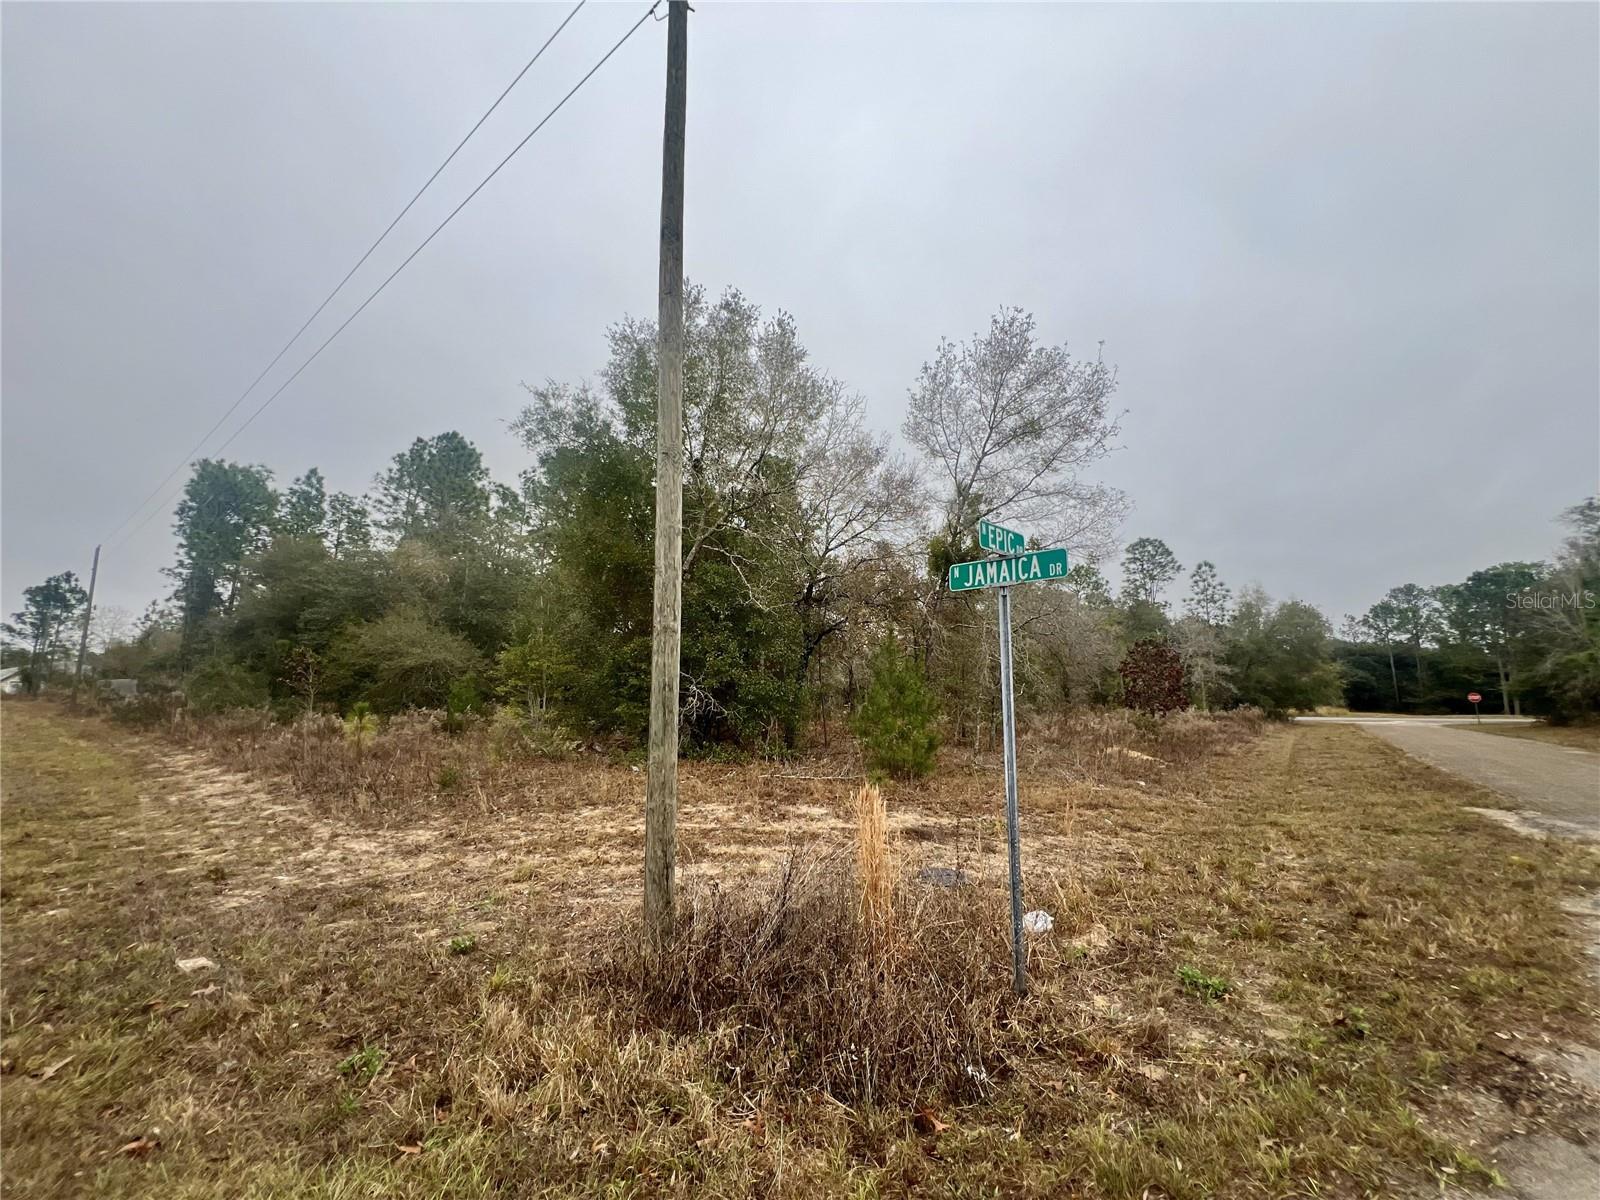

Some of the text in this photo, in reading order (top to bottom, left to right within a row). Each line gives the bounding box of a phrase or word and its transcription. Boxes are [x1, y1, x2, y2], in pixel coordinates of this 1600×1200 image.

[988, 525, 1015, 554] EPIC
[954, 555, 1063, 587] N JAMAICA DR
